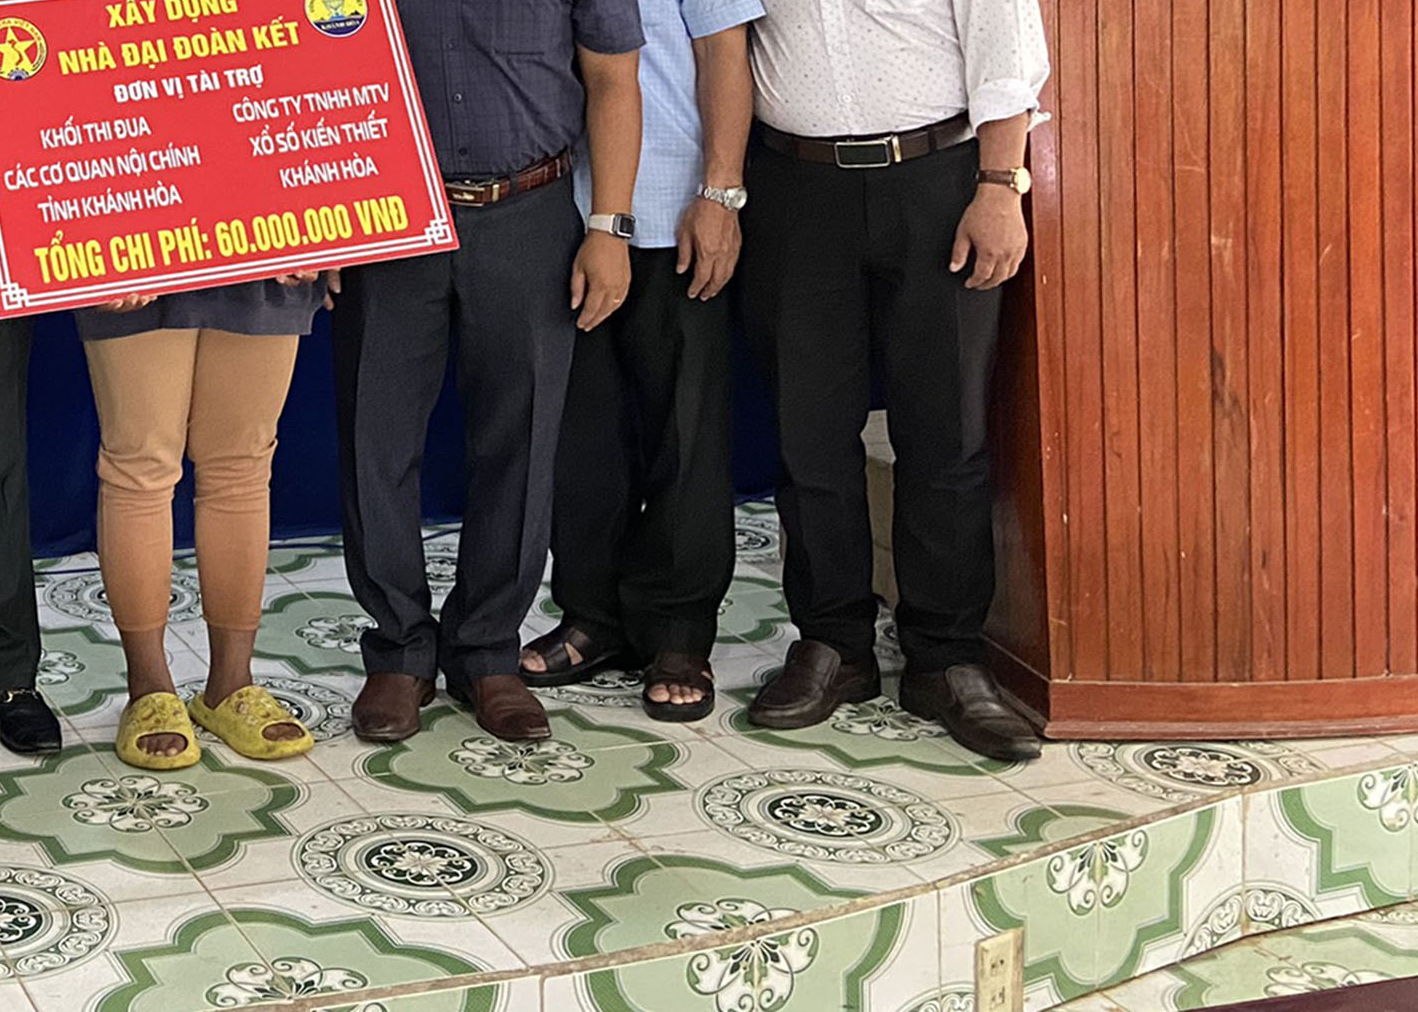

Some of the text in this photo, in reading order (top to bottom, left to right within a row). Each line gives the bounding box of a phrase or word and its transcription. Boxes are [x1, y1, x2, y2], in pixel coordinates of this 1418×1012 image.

[57, 41, 117, 76] NHÀ
[120, 38, 168, 70] ĐẠI
[173, 26, 248, 61] ĐOÀN
[251, 15, 300, 50] KẾT
[113, 63, 264, 104] ĐƠN VỊ TÀI TRỢ
[232, 82, 391, 123] CÔNG TY TNHH MTV
[39, 115, 152, 150] KHỐI THI ĐUA
[248, 109, 389, 157] XỔ SỐ KIẾN THIẾT
[3, 142, 202, 190] CÁC CƠ QUAN NỘI CHÍNH
[278, 152, 380, 188] KHÁNH HÒA
[36, 180, 183, 223] TỈNH KHÁNH HÒA
[34, 195, 409, 283] TỔNG CHI PHÍ: 60.000.000 VNĐ
